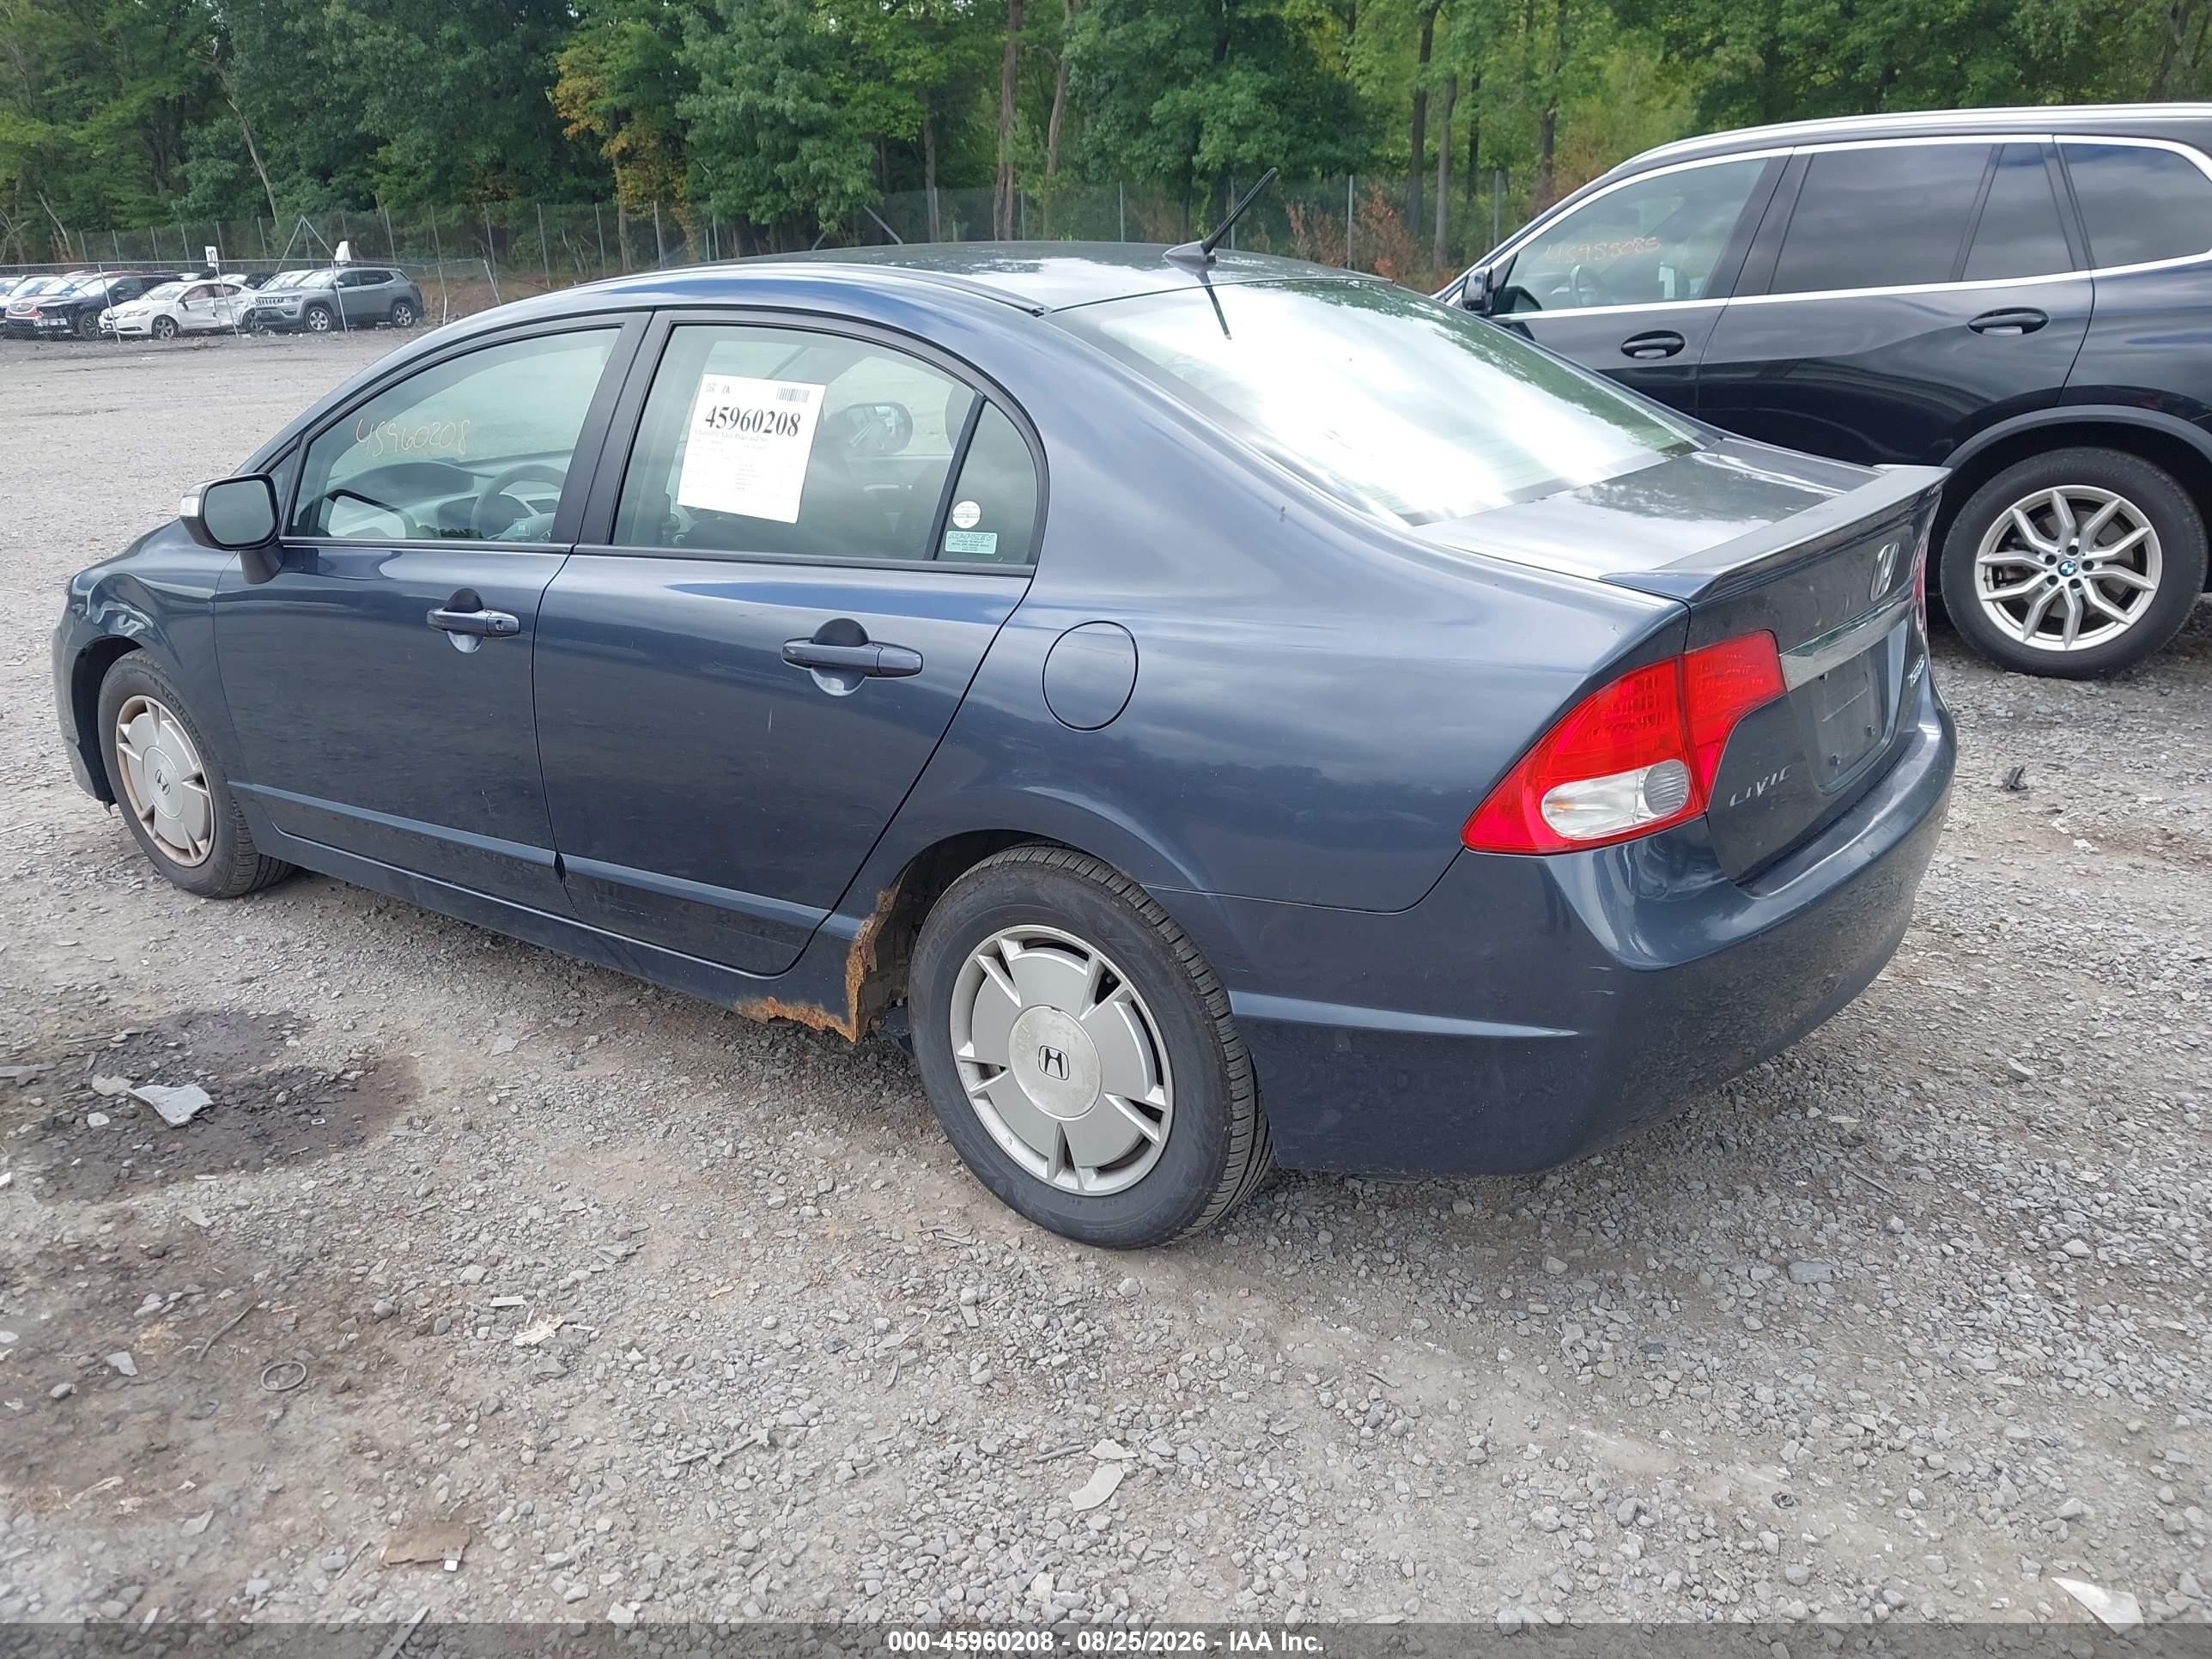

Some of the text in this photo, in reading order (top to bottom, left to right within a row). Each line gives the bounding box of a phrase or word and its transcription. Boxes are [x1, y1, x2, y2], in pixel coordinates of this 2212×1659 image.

[355, 418, 471, 458] 45960208
[705, 404, 801, 437] 45960208
[1729, 763, 1792, 807] CIVIC
